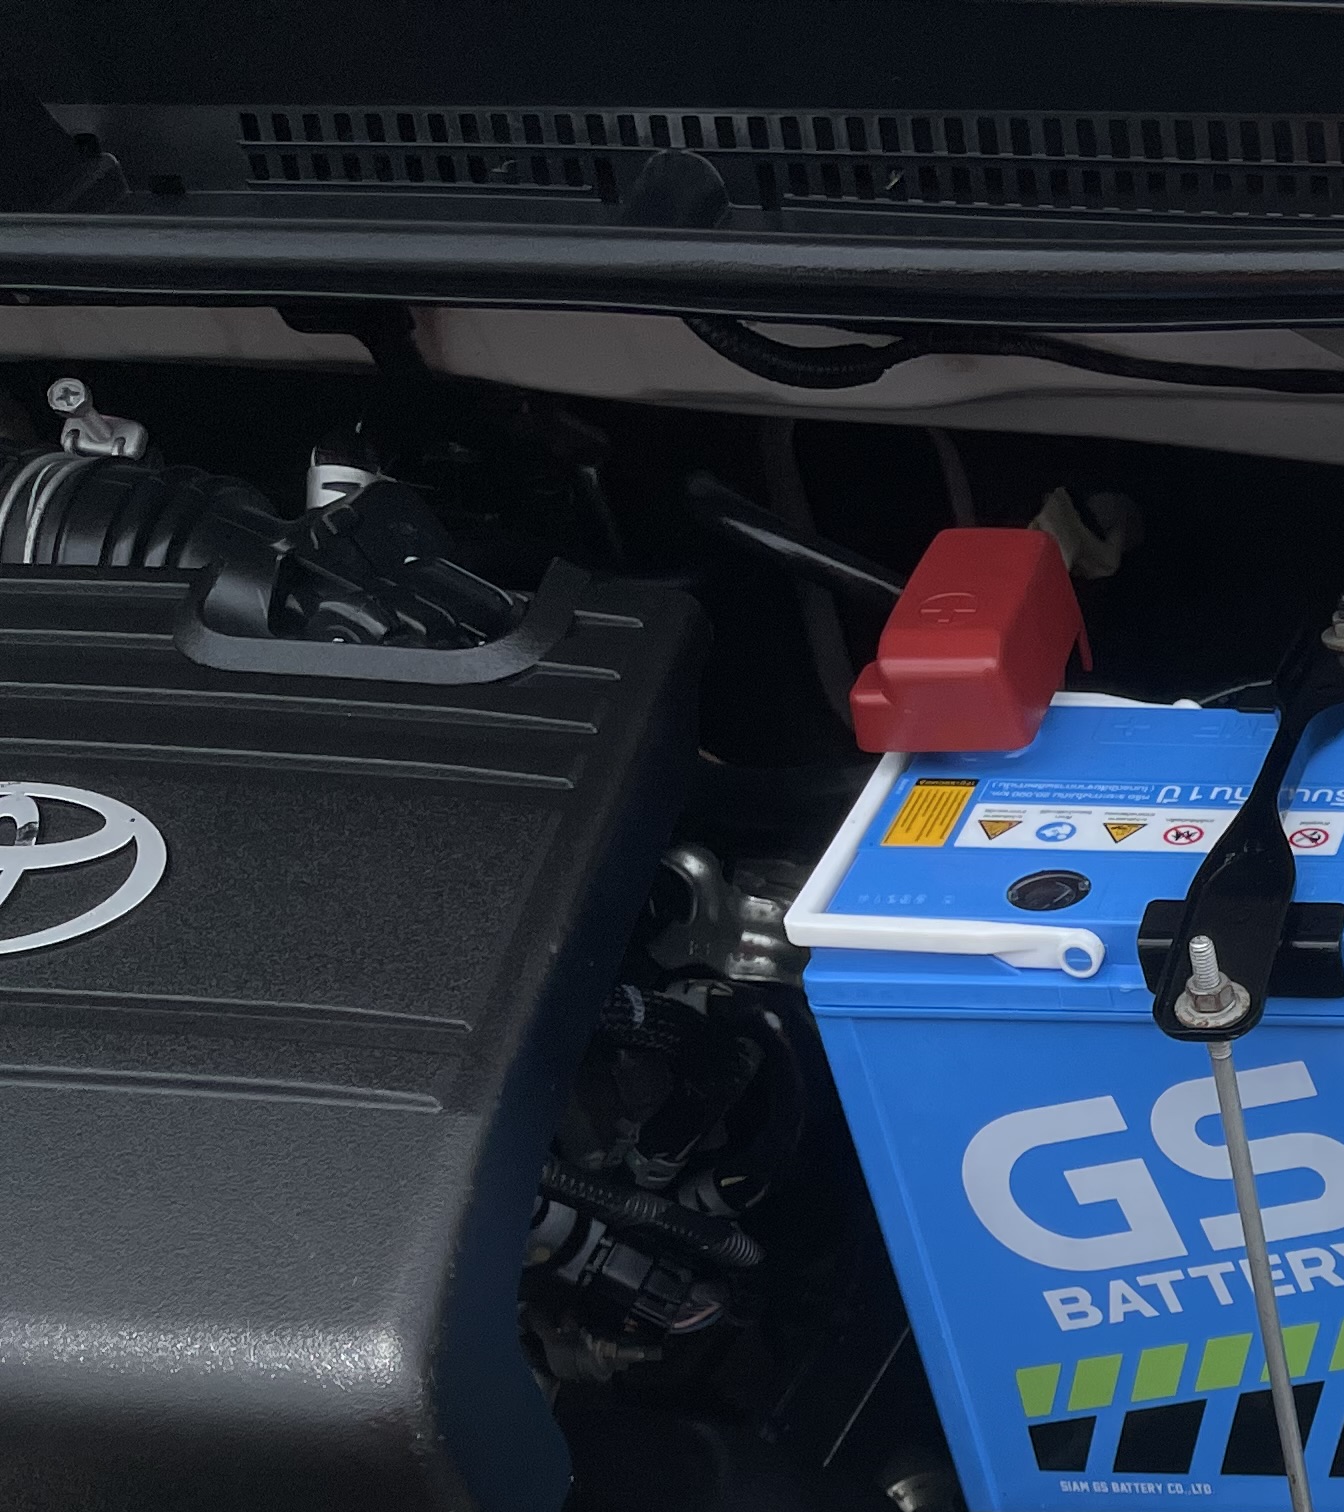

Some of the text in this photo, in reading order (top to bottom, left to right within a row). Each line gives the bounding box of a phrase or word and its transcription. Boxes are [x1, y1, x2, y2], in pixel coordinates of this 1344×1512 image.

[1156, 785, 1181, 804] ปี
[1060, 1480, 1091, 1493] SIAM
[1093, 1481, 1109, 1493] GS
[1111, 1482, 1164, 1495] BATTERY
